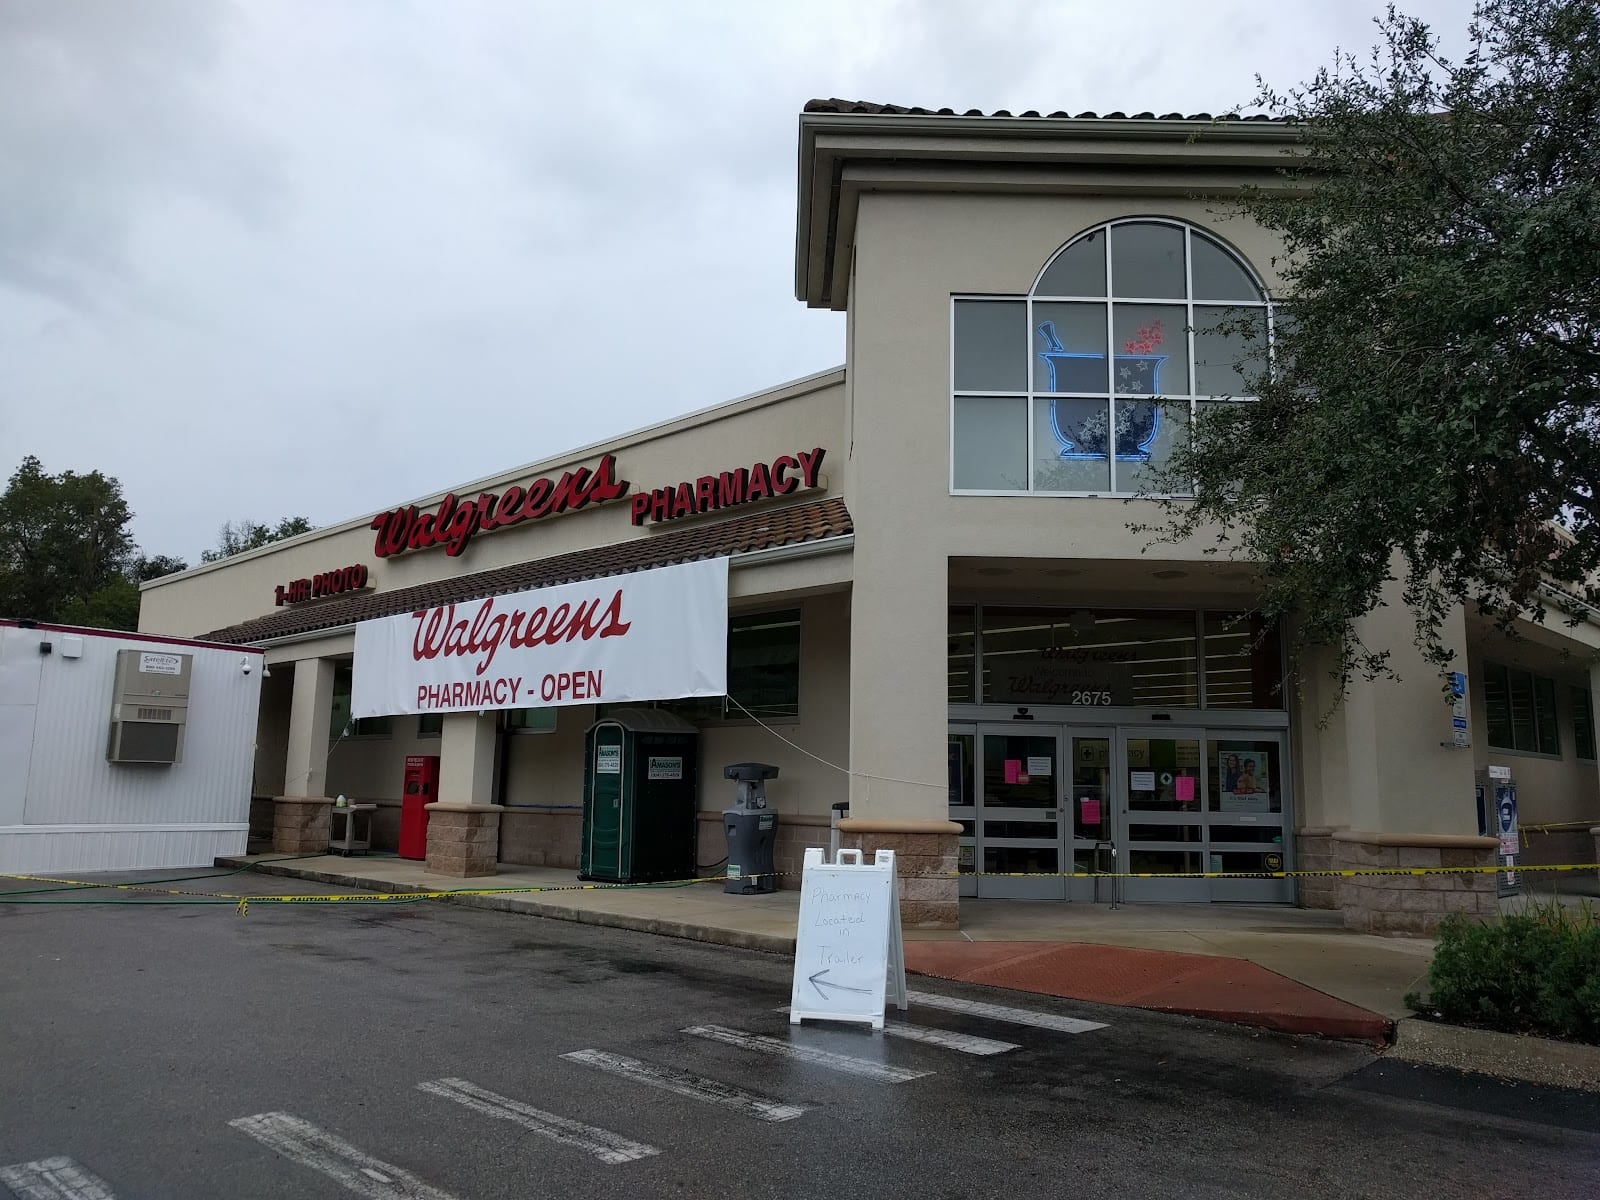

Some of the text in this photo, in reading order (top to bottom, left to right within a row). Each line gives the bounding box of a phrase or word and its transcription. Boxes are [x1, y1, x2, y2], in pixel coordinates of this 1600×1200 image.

[371, 454, 630, 557] Walgreens
[631, 448, 827, 526] PHARMACY
[275, 564, 368, 606] 1-HR PHOTO
[411, 589, 632, 676] Walgreens
[417, 677, 522, 709] PHARMACY
[541, 669, 603, 701] OPEN
[1071, 691, 1112, 705] 2675
[815, 911, 866, 927] Located
[839, 927, 850, 937] in
[817, 945, 865, 965] Trailer
